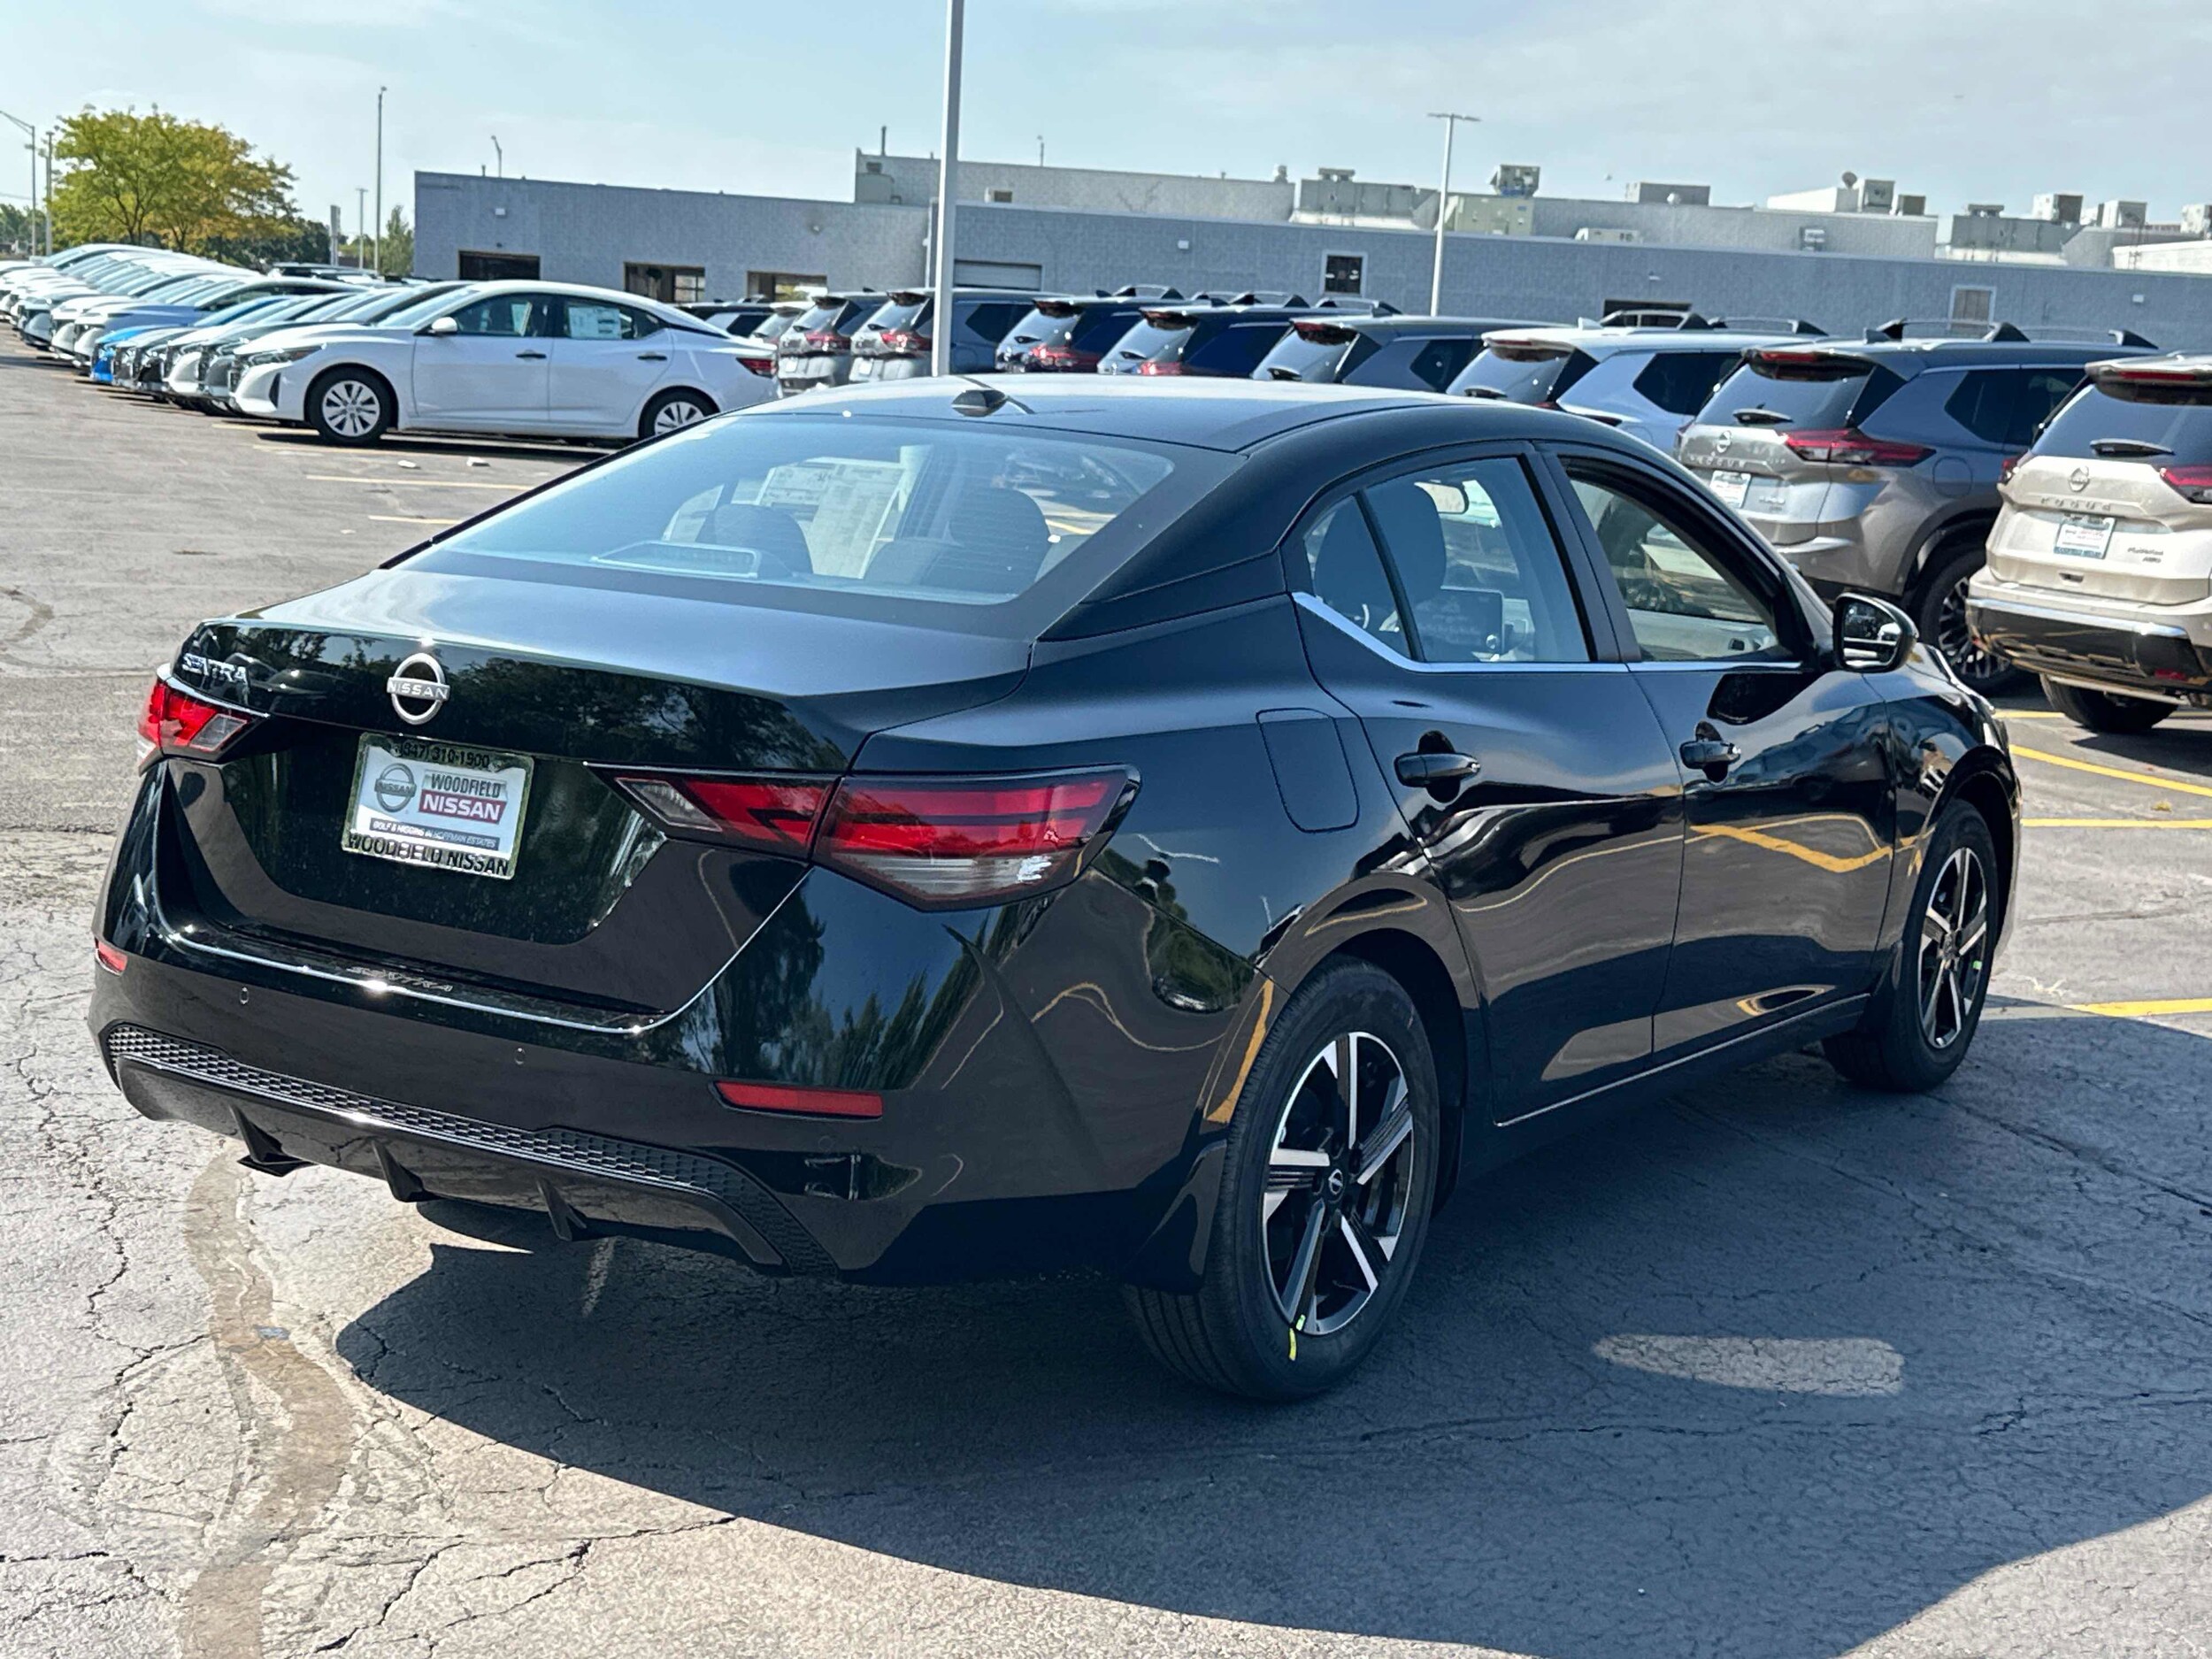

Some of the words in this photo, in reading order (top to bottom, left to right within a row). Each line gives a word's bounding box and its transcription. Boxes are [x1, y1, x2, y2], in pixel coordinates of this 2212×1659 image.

[387, 680, 449, 700] NISSAN
[431, 773, 502, 798] WOODFIELD
[423, 794, 500, 820] NISSAN
[348, 833, 442, 864] WOODFIELD
[446, 850, 509, 876] NISSAN
